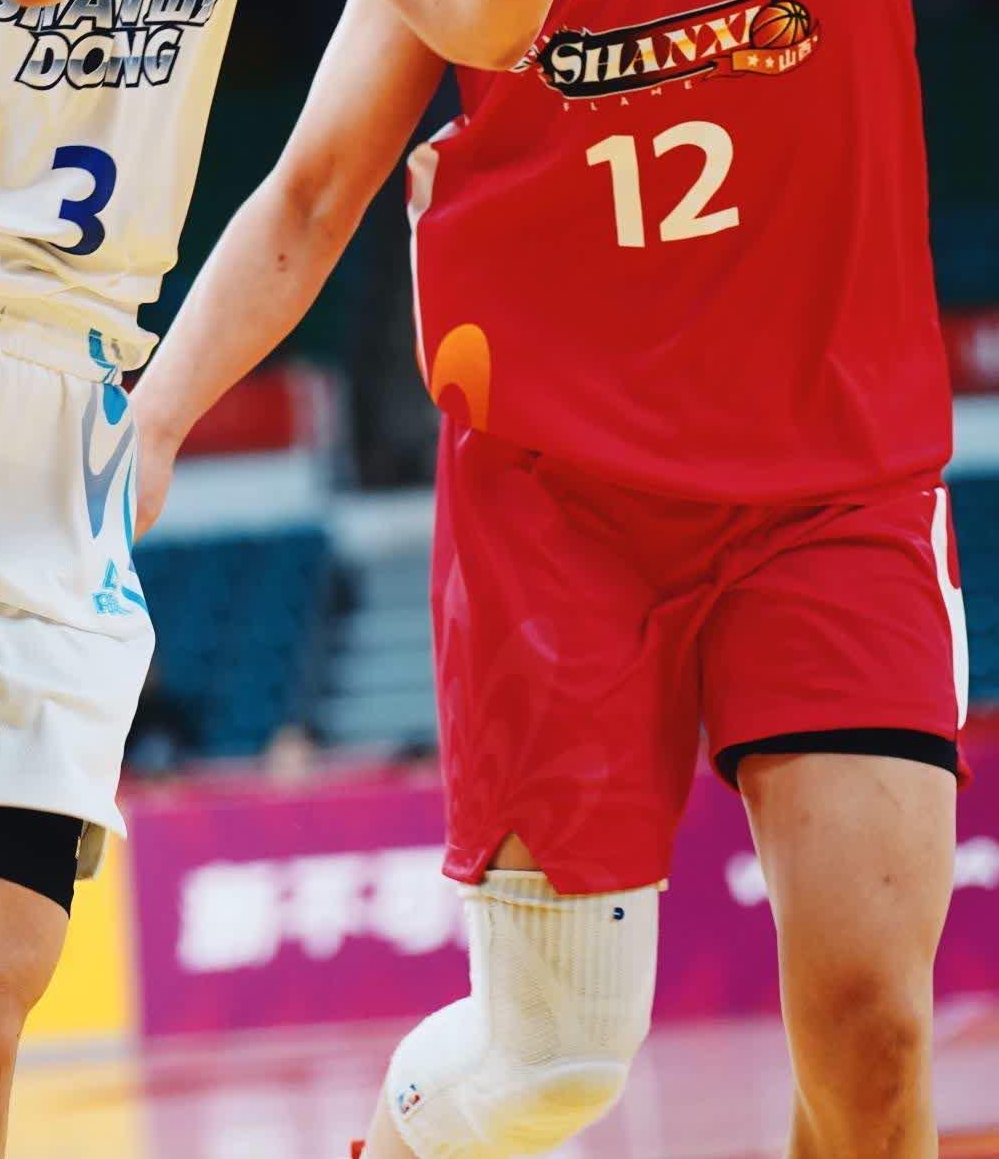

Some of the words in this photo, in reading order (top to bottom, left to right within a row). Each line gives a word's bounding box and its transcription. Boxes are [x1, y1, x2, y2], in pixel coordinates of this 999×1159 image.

[14, 24, 184, 91] DONG
[551, 5, 762, 84] SHANXI
[48, 145, 118, 256] 3
[585, 120, 740, 248] 12
